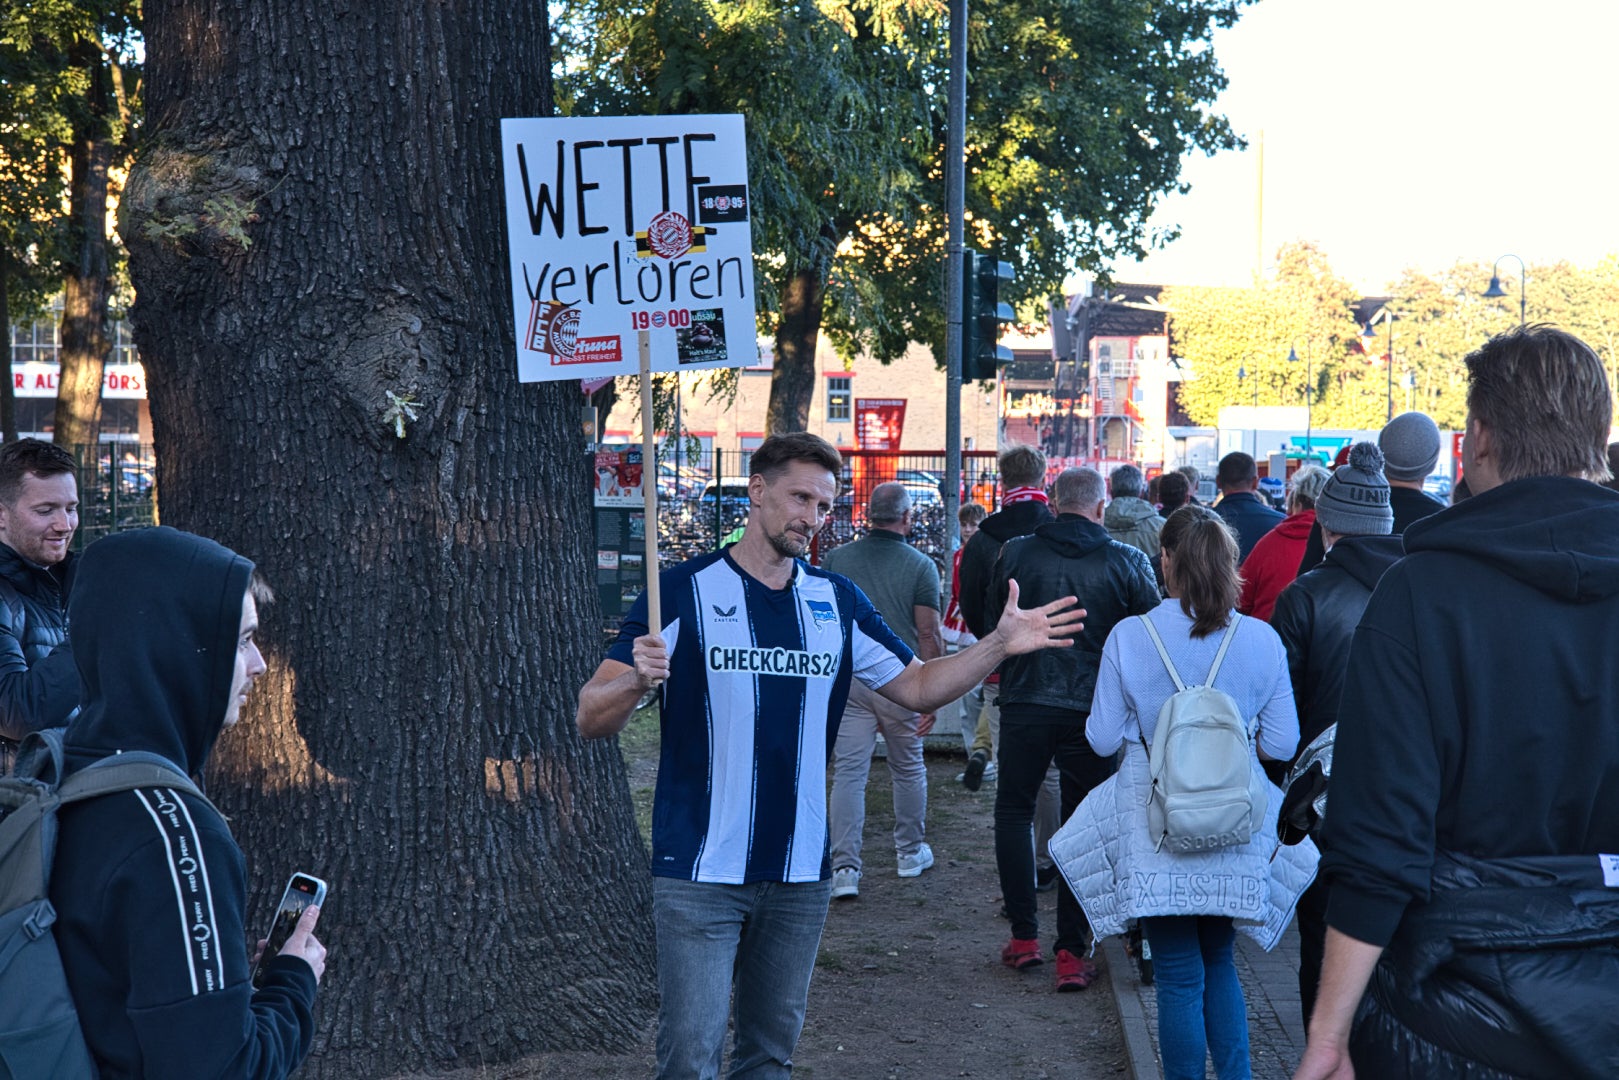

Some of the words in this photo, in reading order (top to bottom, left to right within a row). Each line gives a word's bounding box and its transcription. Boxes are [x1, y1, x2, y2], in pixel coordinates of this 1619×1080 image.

[516, 133, 717, 240] WETTE
[179, 835, 190, 857] PERRY
[188, 874, 199, 893] FRED
[194, 901, 204, 923] PERRY
[200, 941, 210, 960] FRED
[204, 968, 215, 991] PERRY
